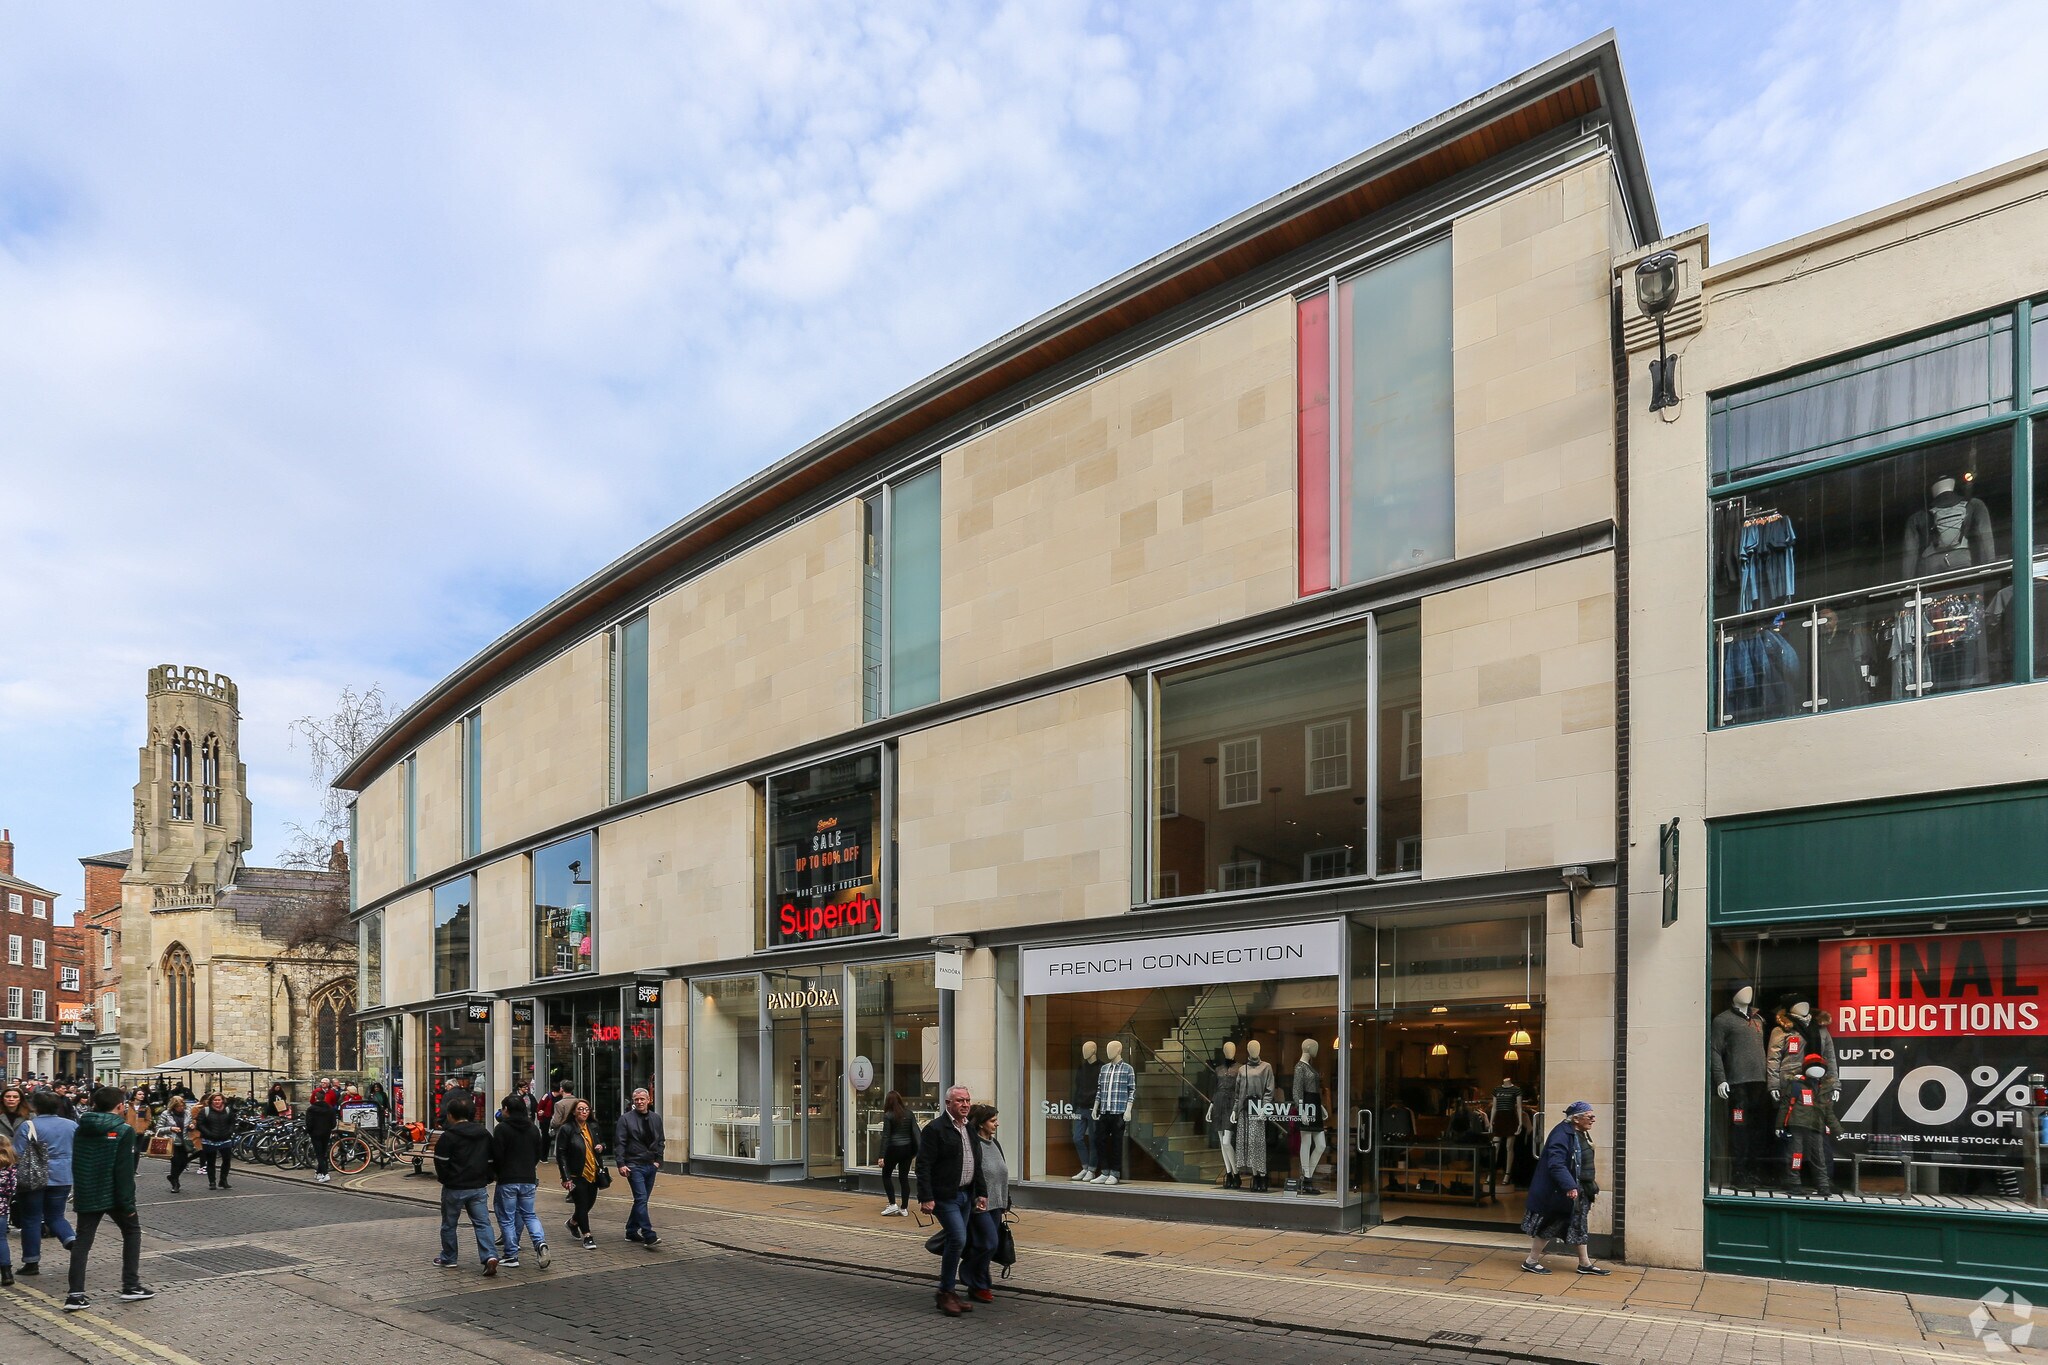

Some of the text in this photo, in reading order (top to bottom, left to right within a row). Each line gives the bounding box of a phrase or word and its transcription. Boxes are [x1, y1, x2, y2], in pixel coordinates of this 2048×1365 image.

[813, 830, 841, 851] SALE
[796, 857, 807, 872] UP
[809, 854, 819, 869] TO
[843, 845, 860, 862] OFF
[796, 888, 813, 898] MORE
[780, 892, 881, 939] Superdry
[1049, 944, 1303, 977] FRENCH CONNECTION
[1839, 937, 2039, 1001] FINAL
[1839, 1002, 2039, 1032] REDUCTIONS
[1839, 1048, 1895, 1060] UP TO
[1041, 1100, 1073, 1115] Sale
[1248, 1099, 1316, 1116] New in
[1838, 1065, 2031, 1126] 70%
[1923, 1136, 1959, 1144] WHILE
[1961, 1136, 1999, 1145] STOCK
